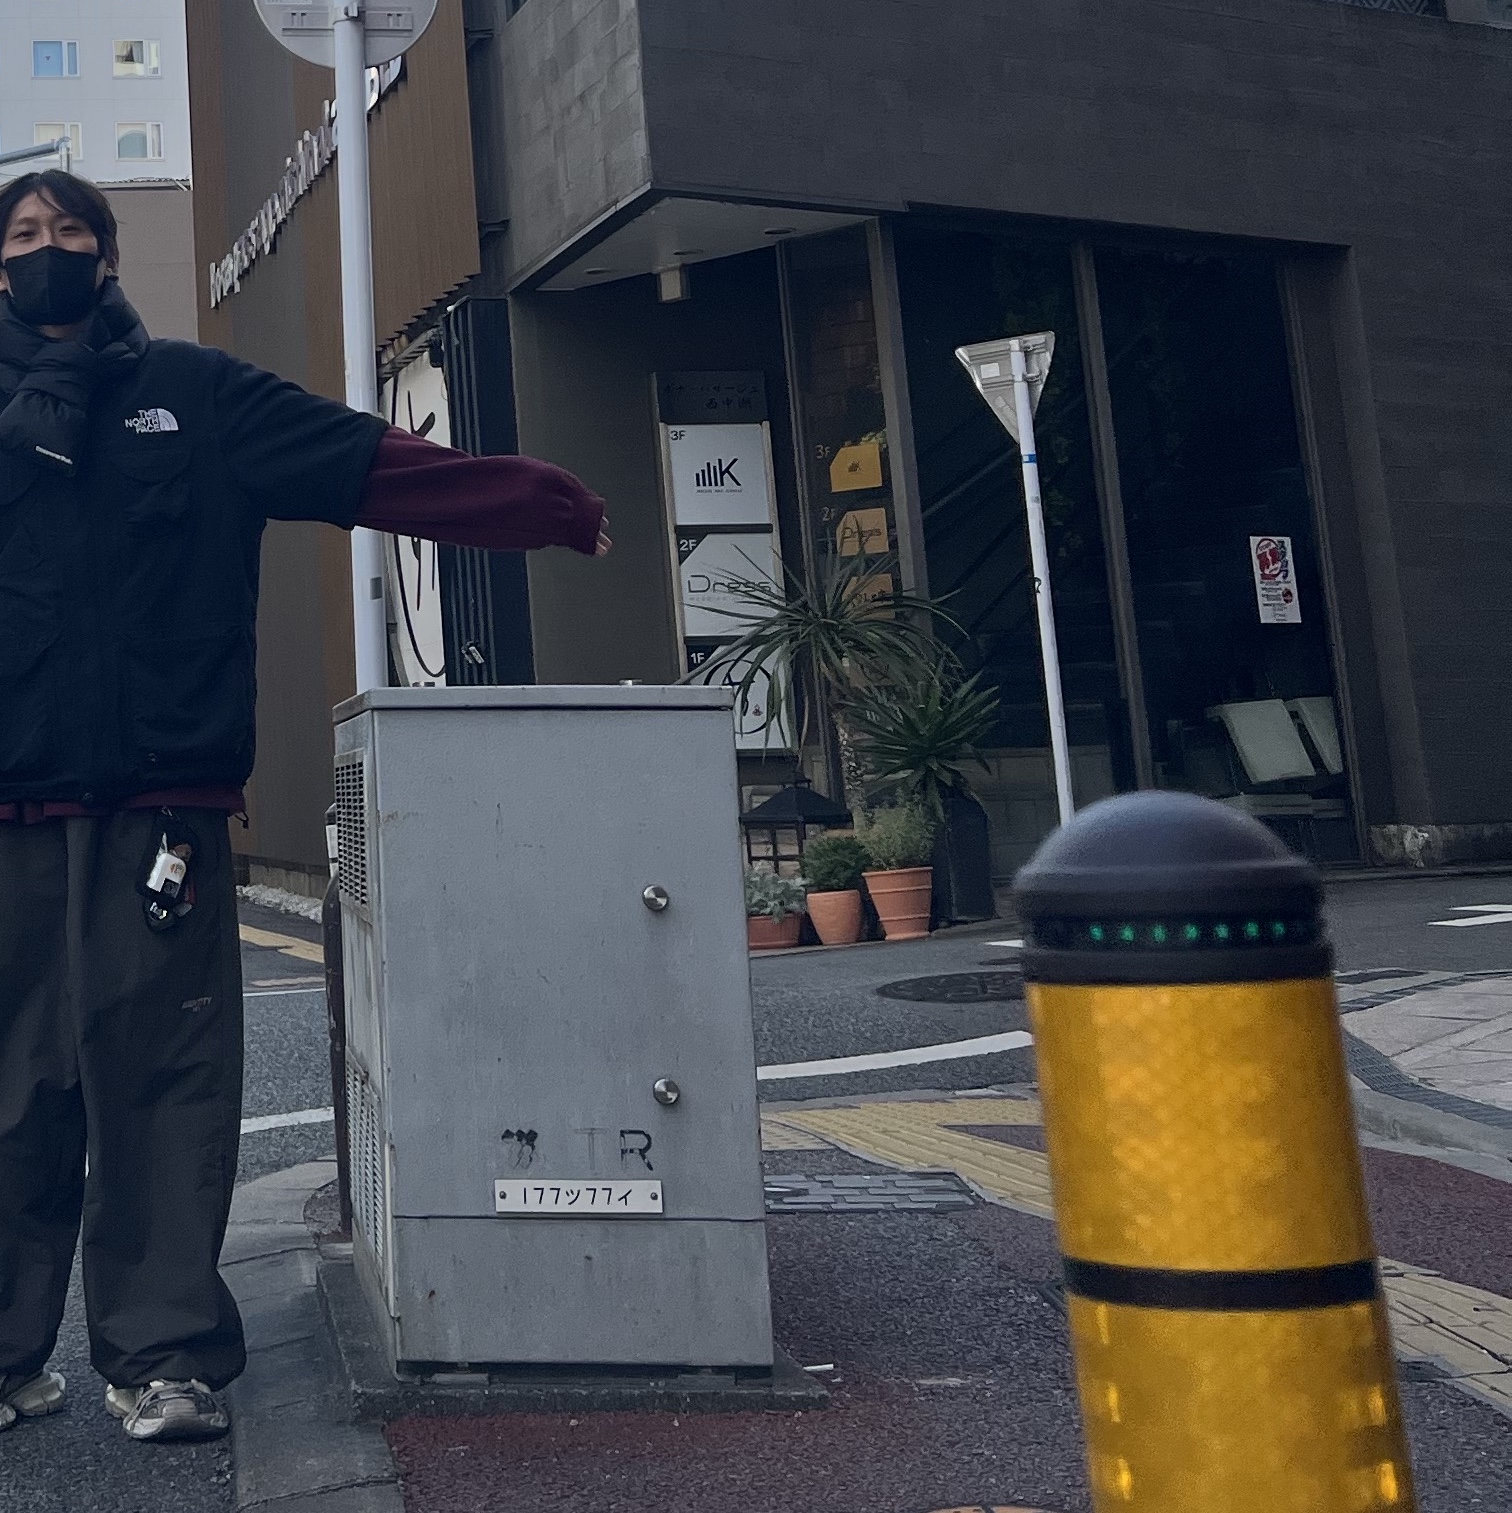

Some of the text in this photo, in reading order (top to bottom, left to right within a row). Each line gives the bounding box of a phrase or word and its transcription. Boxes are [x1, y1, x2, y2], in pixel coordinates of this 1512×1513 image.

[138, 408, 157, 419] THE
[124, 415, 159, 428] NORTH
[135, 423, 161, 434] FACE
[670, 430, 687, 441] 3F
[815, 444, 831, 459] 3F
[679, 538, 698, 552] 2F
[690, 652, 705, 664] 1F
